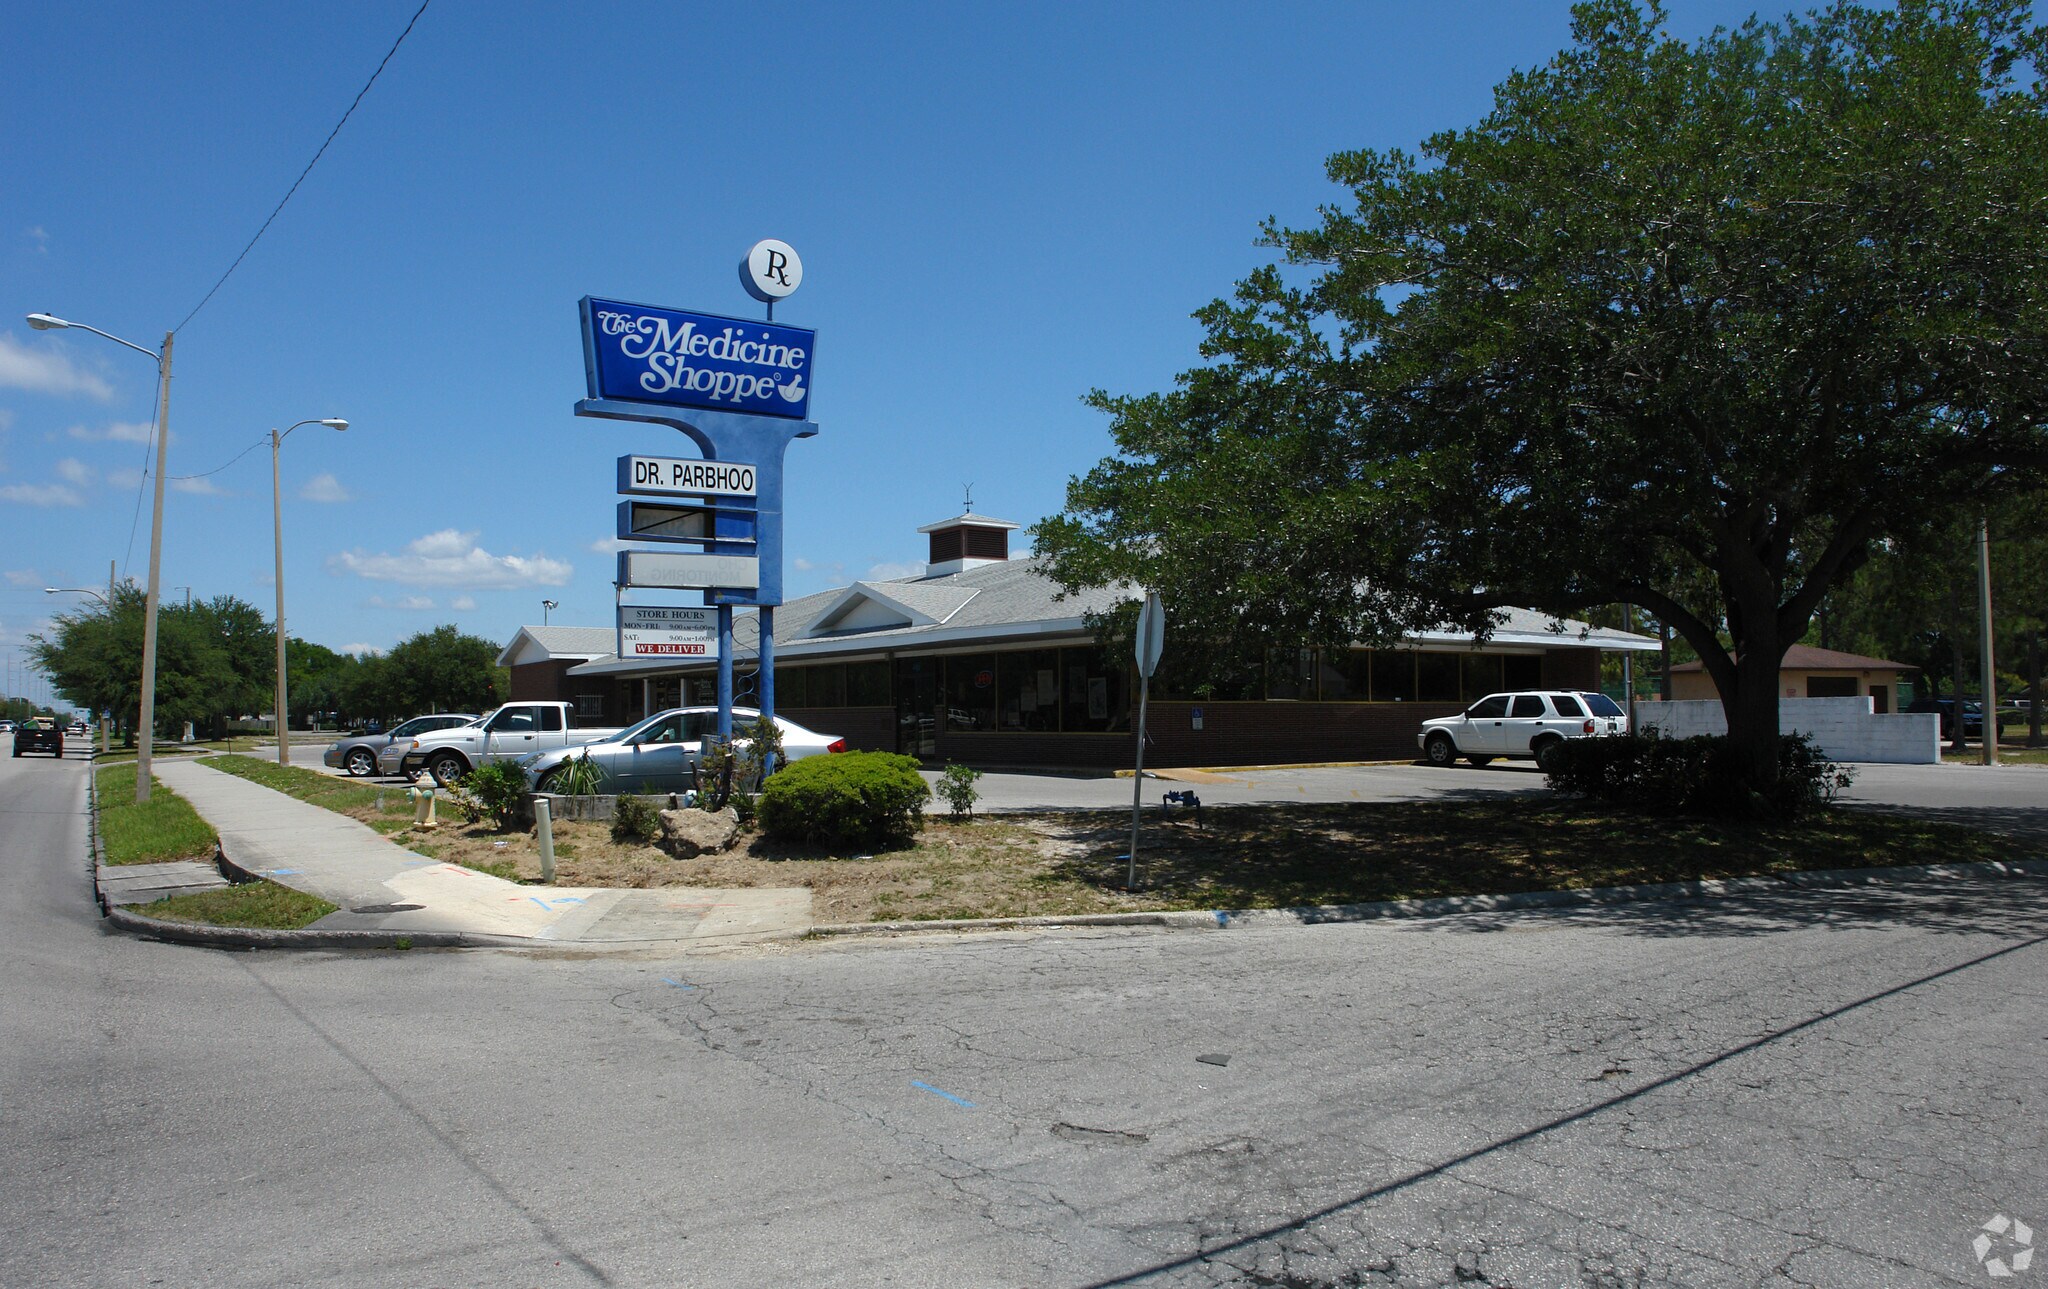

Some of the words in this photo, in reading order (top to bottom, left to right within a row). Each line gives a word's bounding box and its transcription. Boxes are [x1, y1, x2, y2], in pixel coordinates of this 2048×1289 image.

[597, 311, 636, 335] The
[621, 315, 805, 370] Medicine
[640, 351, 774, 403] Shoppe
[635, 461, 664, 485] DR.
[673, 463, 754, 491] PARBHOO
[636, 610, 668, 618] STORE
[672, 610, 705, 619] HOURS
[636, 644, 654, 653] WE
[658, 645, 704, 653] DELIVER
